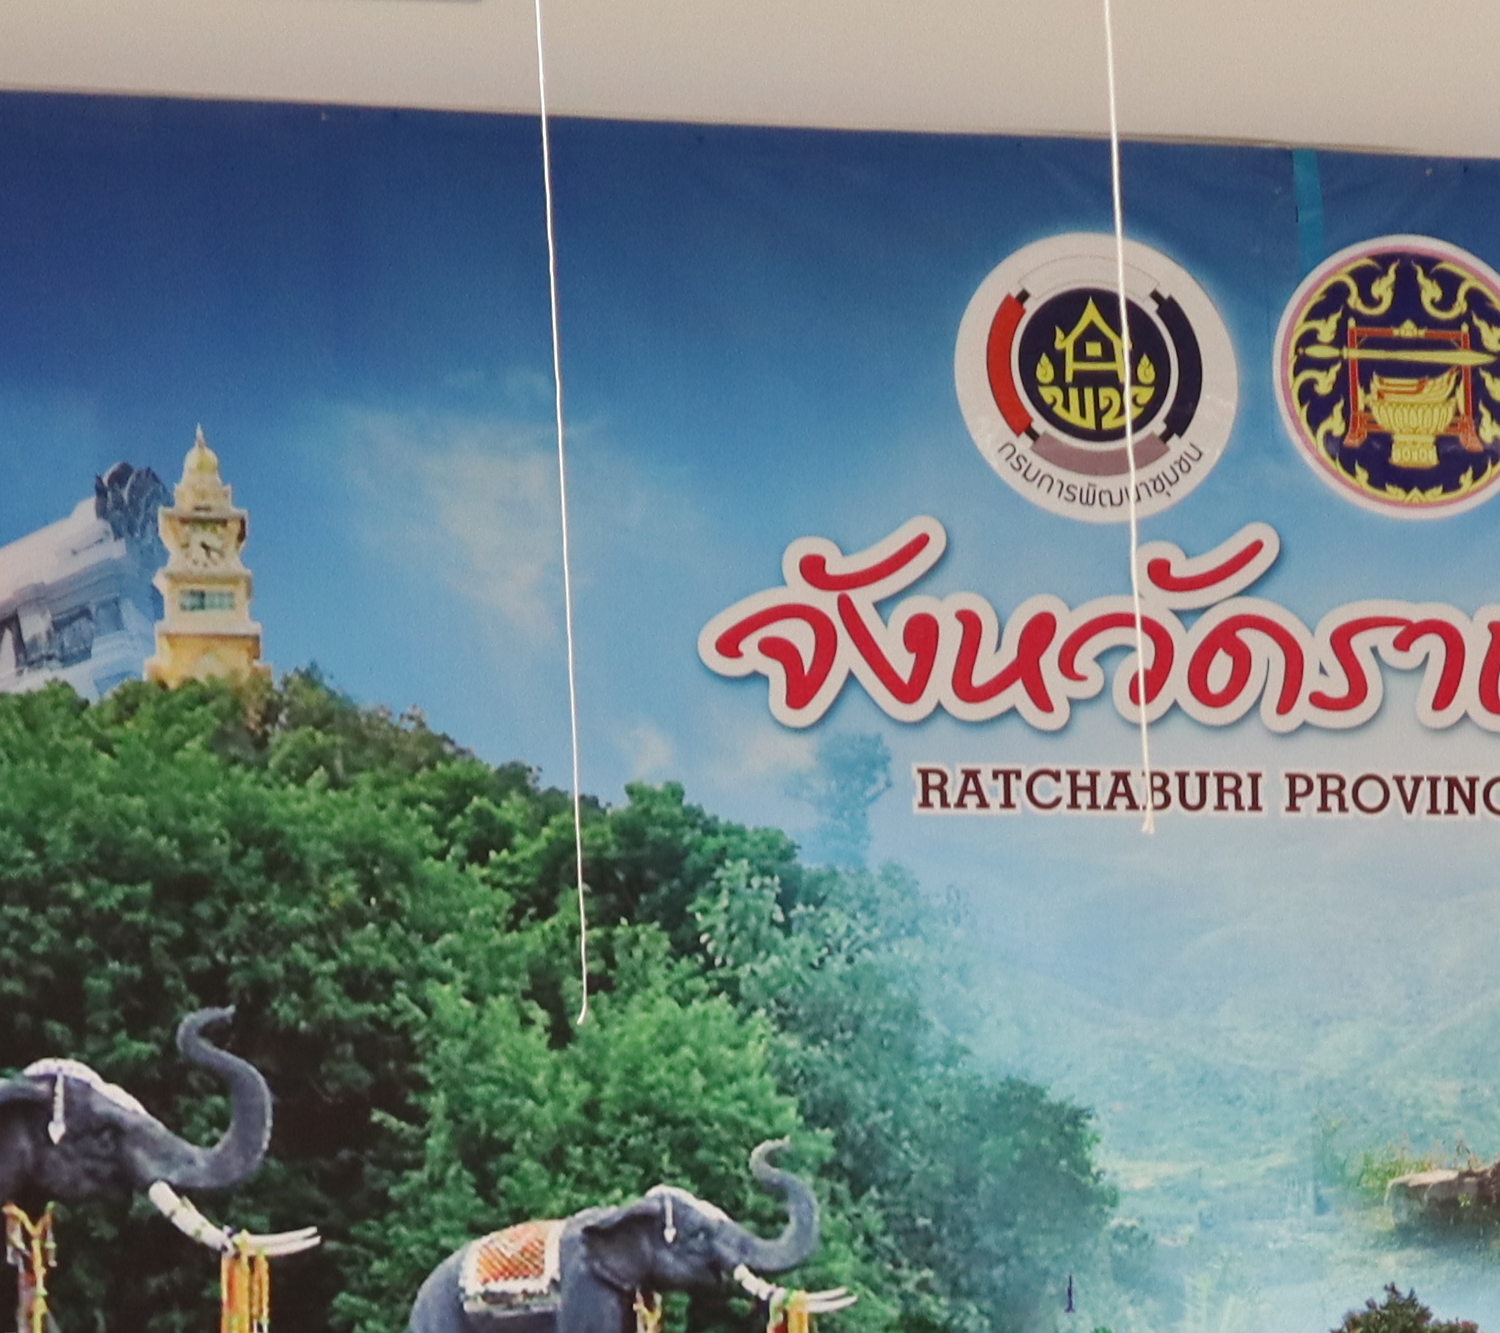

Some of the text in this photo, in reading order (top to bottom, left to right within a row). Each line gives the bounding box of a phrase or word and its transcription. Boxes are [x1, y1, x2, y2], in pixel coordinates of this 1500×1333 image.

[997, 441, 1204, 508] กรมการพัฒนาชุมชน
[916, 767, 1263, 813] RATCHABURI
